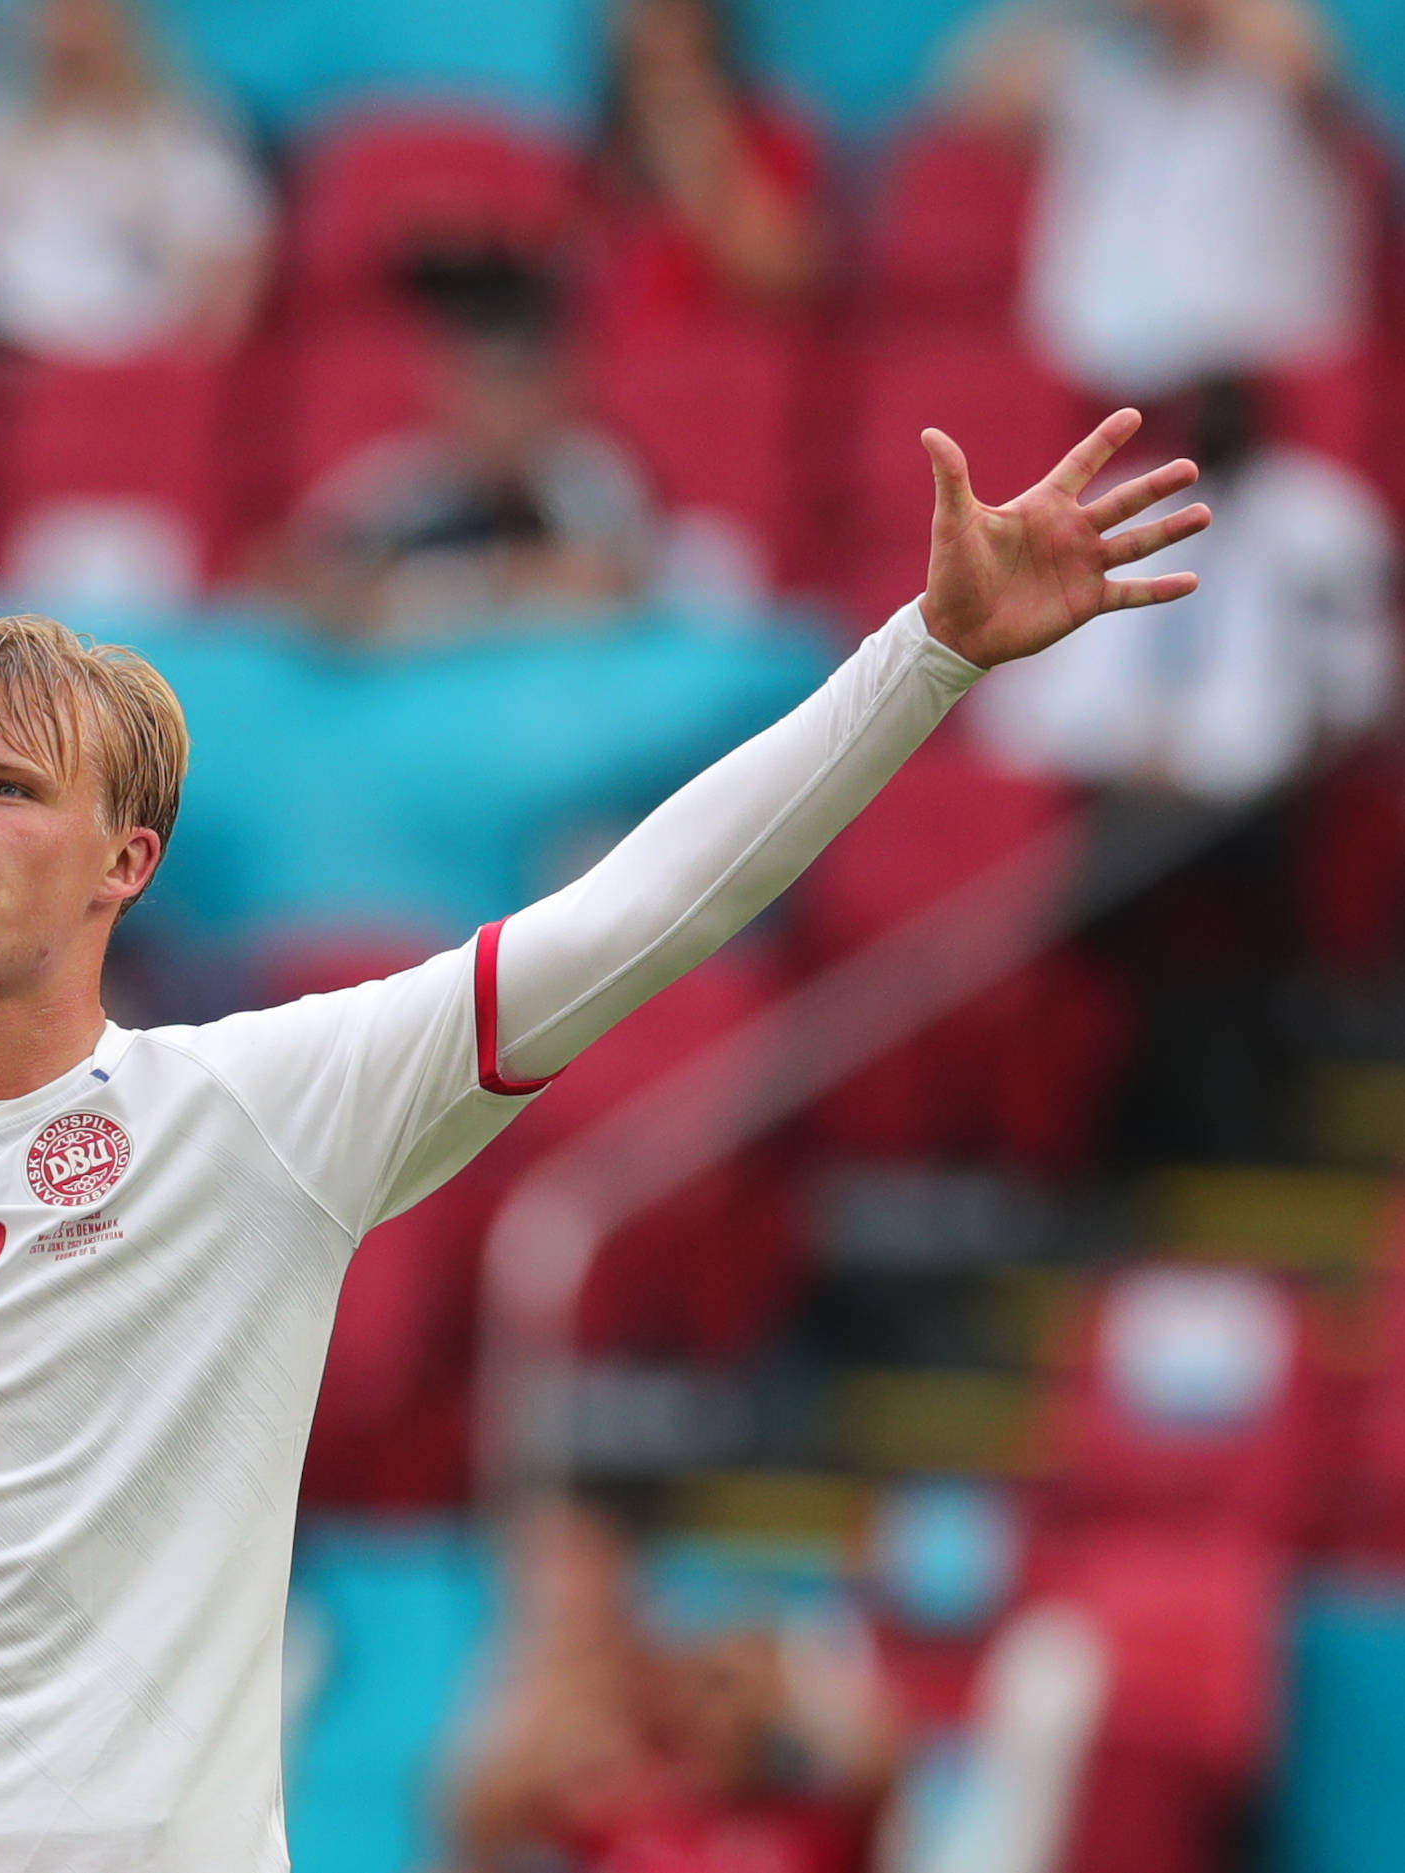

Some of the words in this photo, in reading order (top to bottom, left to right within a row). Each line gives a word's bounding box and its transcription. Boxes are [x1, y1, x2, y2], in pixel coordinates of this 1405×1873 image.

[45, 1139, 113, 1185] DBU
[111, 1129, 130, 1177] UNION
[77, 1219, 118, 1236] DENMARK
[47, 1241, 65, 1252] JUNE
